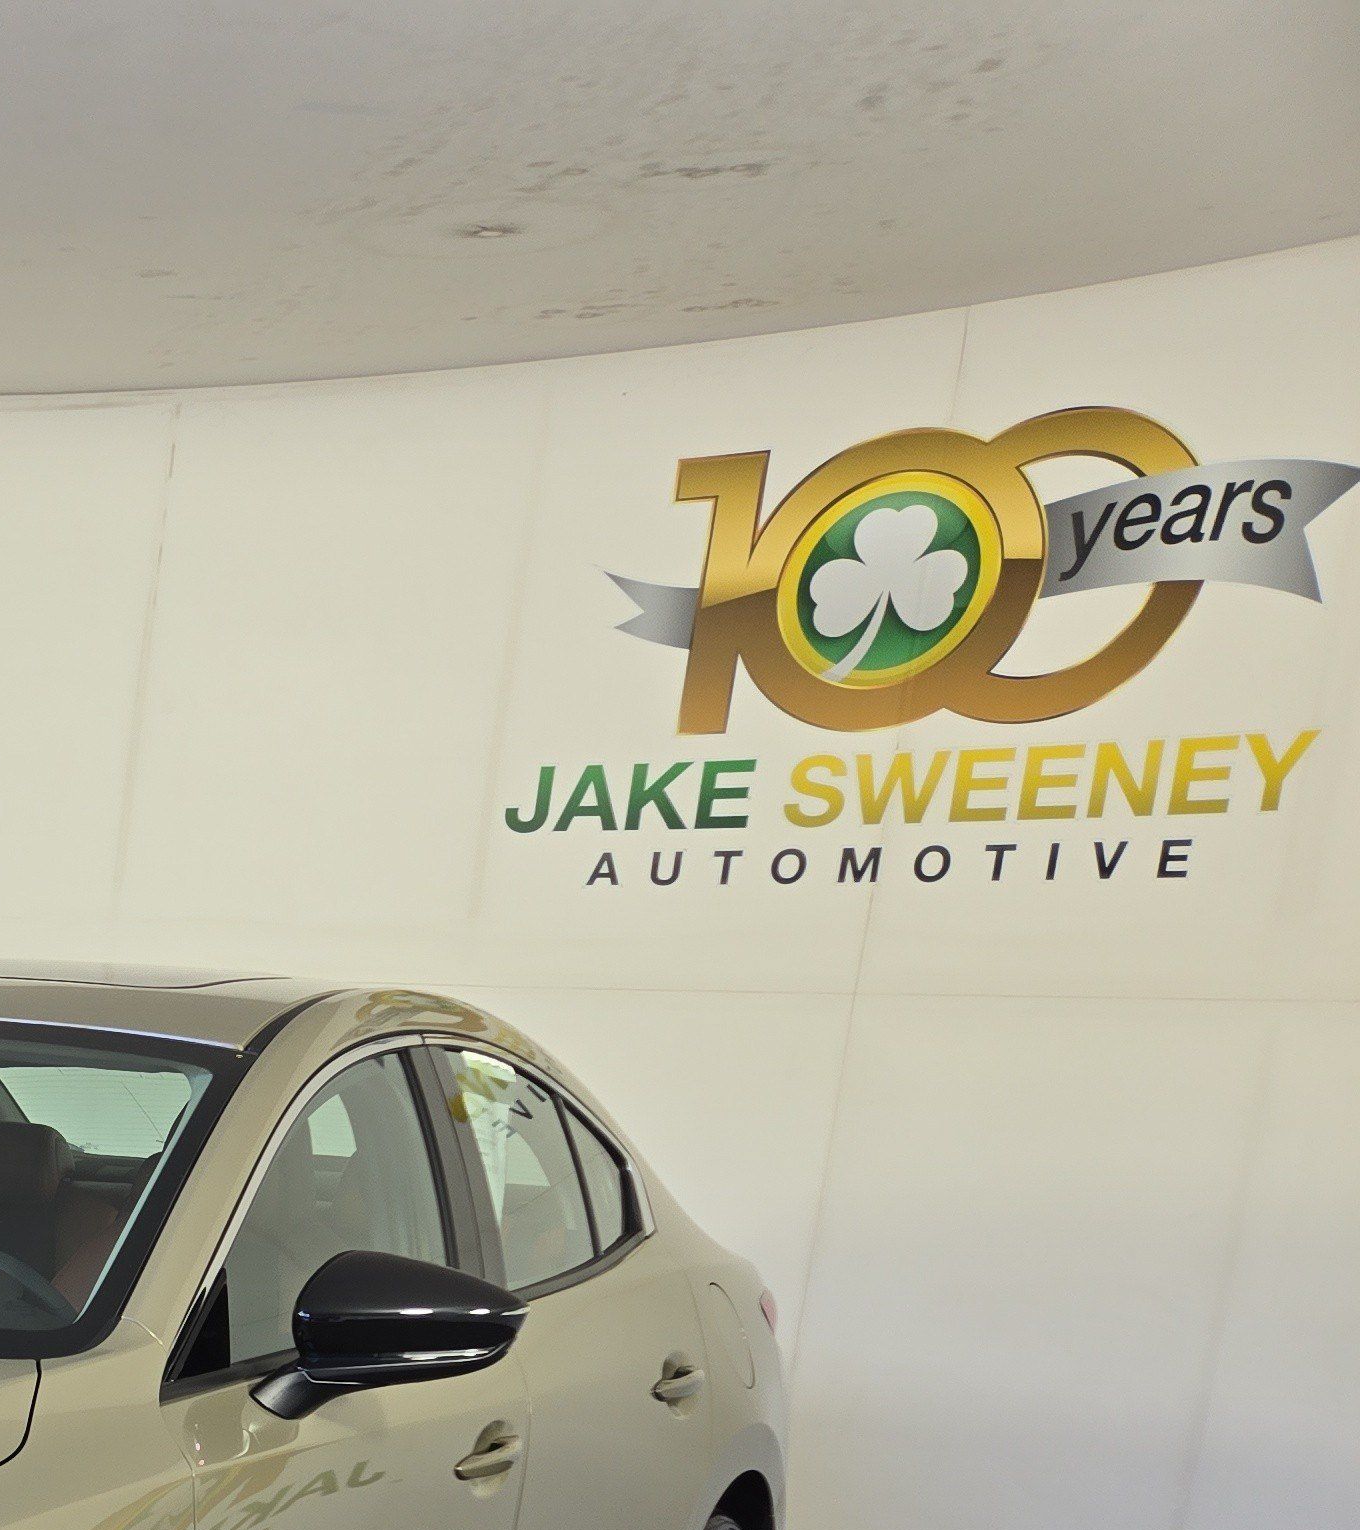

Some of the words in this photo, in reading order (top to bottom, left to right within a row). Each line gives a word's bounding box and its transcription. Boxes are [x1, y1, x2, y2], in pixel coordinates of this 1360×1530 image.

[674, 405, 1204, 735] 100
[1058, 477, 1293, 583] years
[504, 758, 758, 833] JAKE
[783, 729, 1322, 829] SWEENEY
[586, 838, 1194, 887] AUTOMOTIVE
